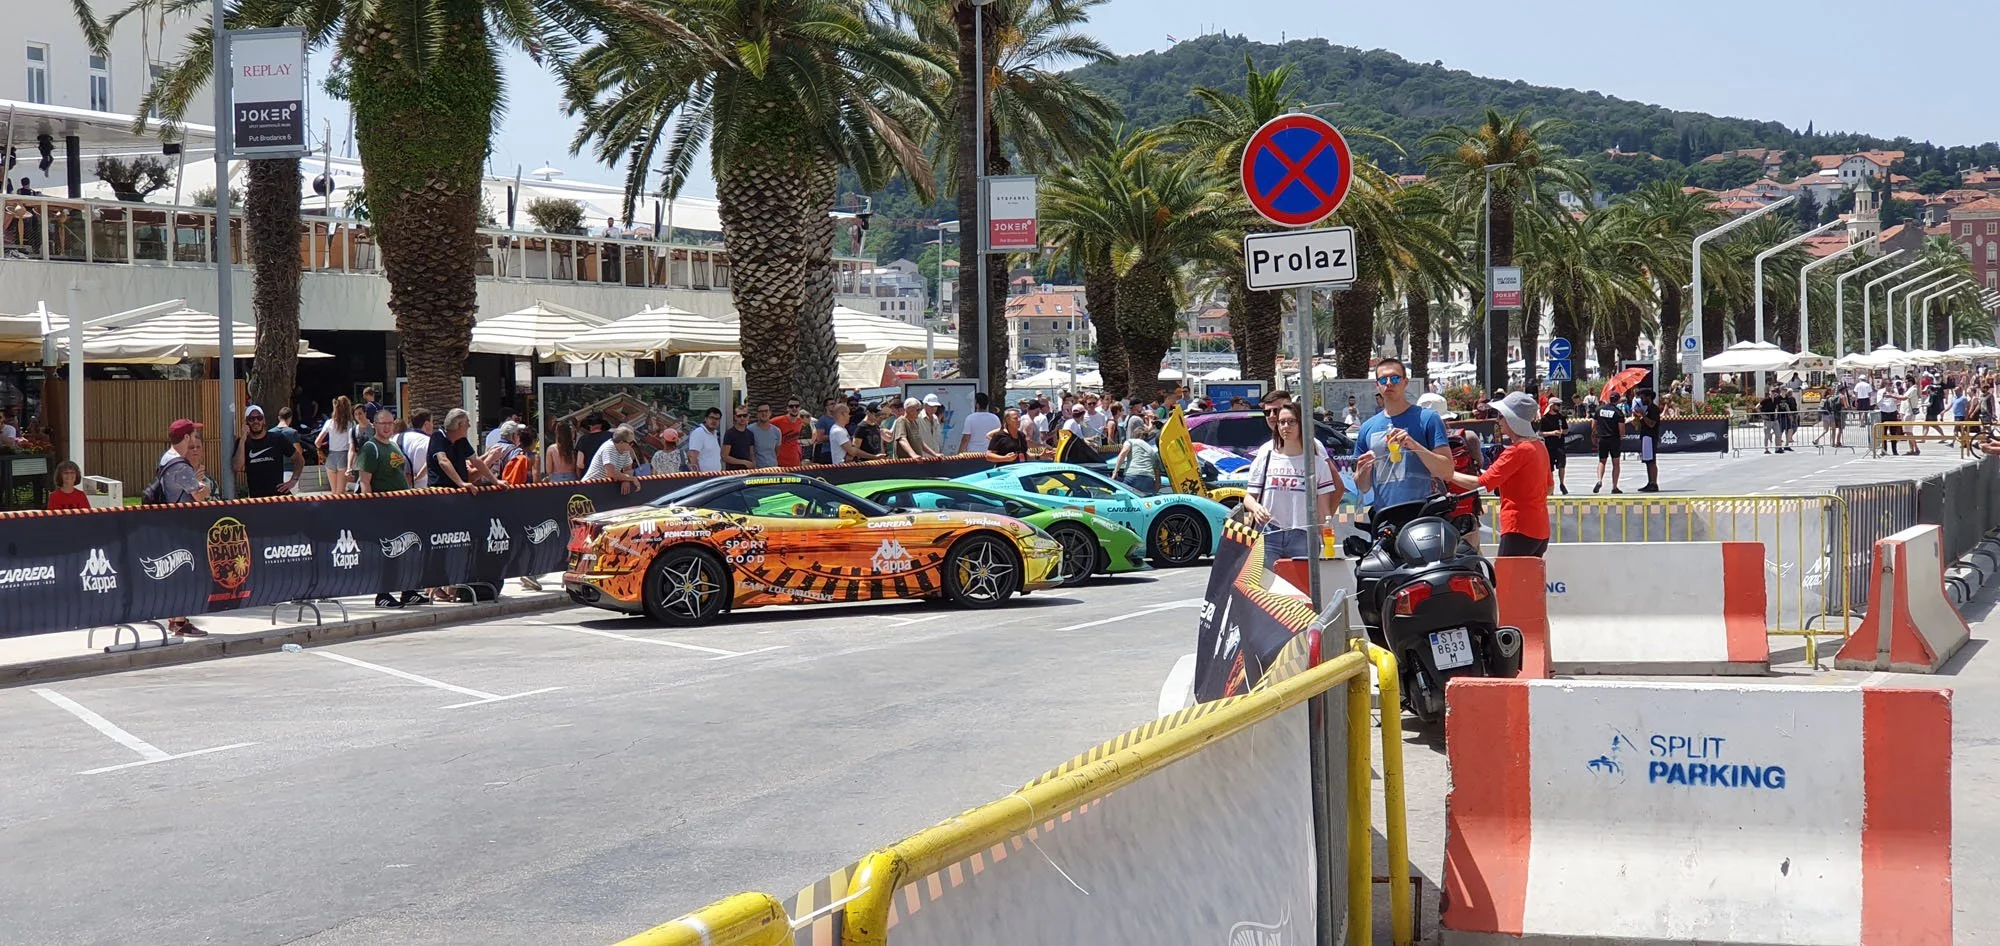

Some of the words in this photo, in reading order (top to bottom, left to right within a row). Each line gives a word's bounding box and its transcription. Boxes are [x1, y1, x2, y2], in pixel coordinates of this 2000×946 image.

[243, 63, 292, 77] REPLAY
[240, 108, 291, 122] JOKER
[994, 223, 1028, 231] JOKER
[1253, 245, 1347, 275] Prolaz
[1271, 477, 1298, 488] NYC
[867, 520, 912, 529] CARRERA
[208, 525, 246, 545] GUM
[430, 531, 471, 545] CARRERA
[264, 543, 312, 559] CARRERA
[487, 540, 509, 554] Kappa
[726, 540, 765, 549] SPORT
[333, 553, 359, 570] Kappa
[726, 555, 765, 564] GOOD
[872, 559, 912, 573] Kappa
[0, 565, 55, 584] CARRERA
[82, 575, 117, 594] Kappa
[1440, 632, 1453, 643] ST
[1437, 641, 1465, 654] 8633
[1449, 653, 1457, 663] M
[1650, 735, 1726, 759] SPLIT
[1649, 761, 1785, 789] PARKING
